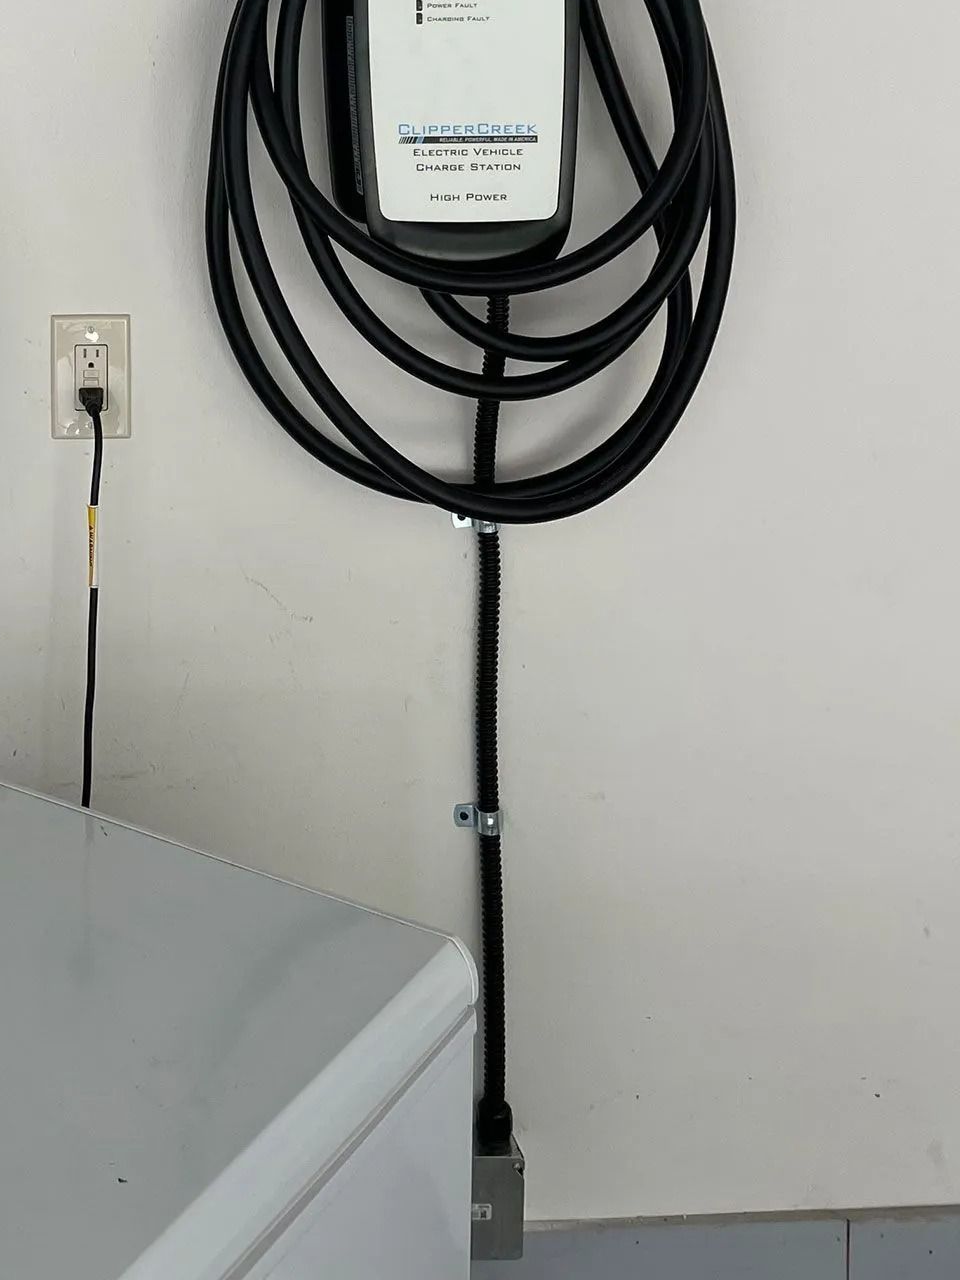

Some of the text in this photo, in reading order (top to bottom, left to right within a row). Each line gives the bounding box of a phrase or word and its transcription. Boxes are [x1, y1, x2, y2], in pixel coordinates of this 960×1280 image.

[398, 123, 538, 135] CLIPPERCREEK
[413, 148, 523, 157] ELECTRIC VEHICLE
[416, 163, 521, 172] CHARGE STATION
[430, 193, 508, 202] HIGH POWER
